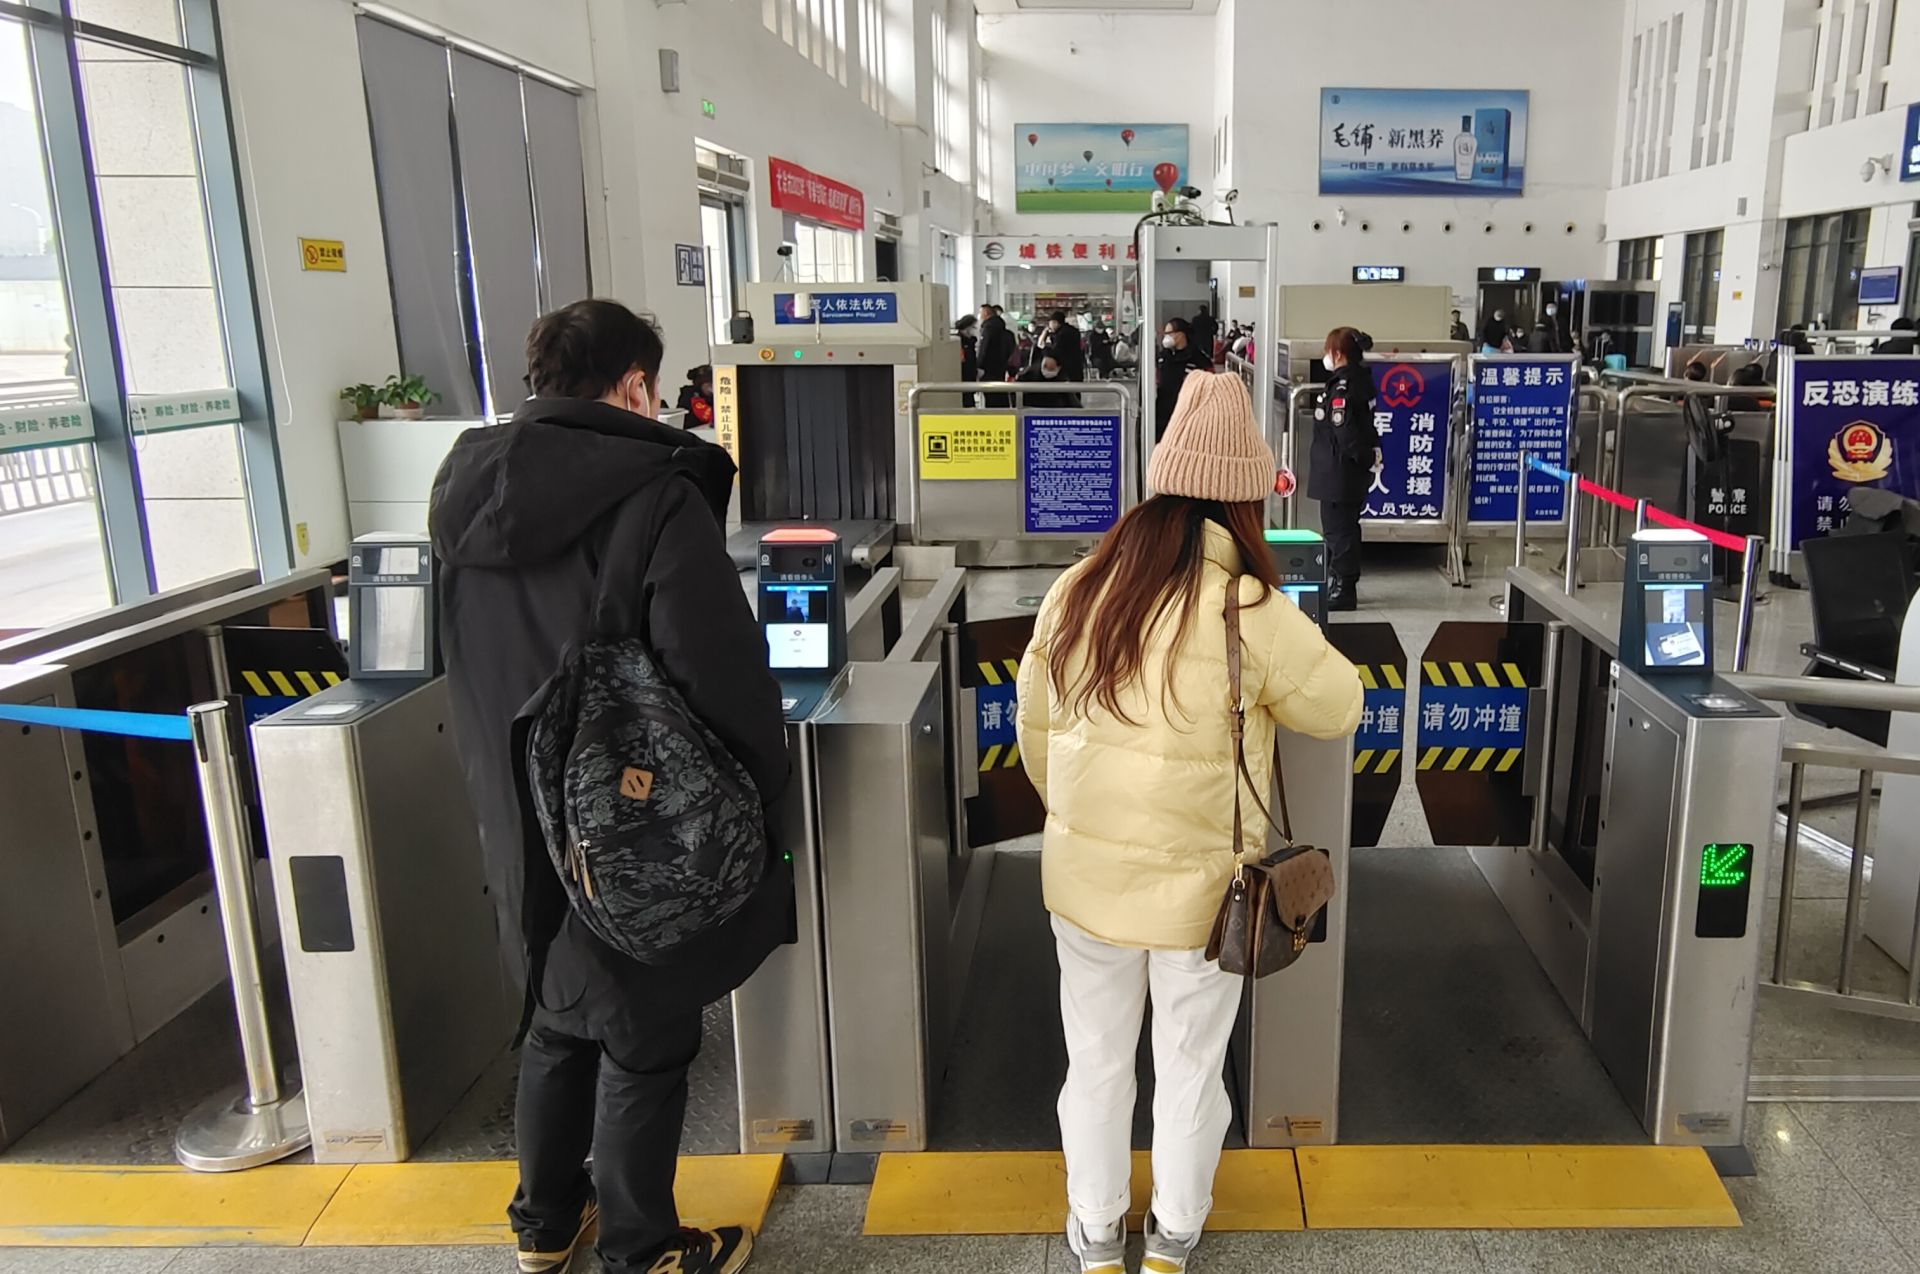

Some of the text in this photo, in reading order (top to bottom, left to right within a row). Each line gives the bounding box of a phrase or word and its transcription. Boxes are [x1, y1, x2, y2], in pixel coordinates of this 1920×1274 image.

[1024, 162, 1145, 177] 中国梦·文明行
[1481, 367, 1564, 386] 温馨提示
[1803, 380, 1919, 406] 反恐演练
[1406, 413, 1435, 496] 消防救援
[1708, 503, 1748, 515] POLICE
[1422, 702, 1522, 733] 请勿冲撞
